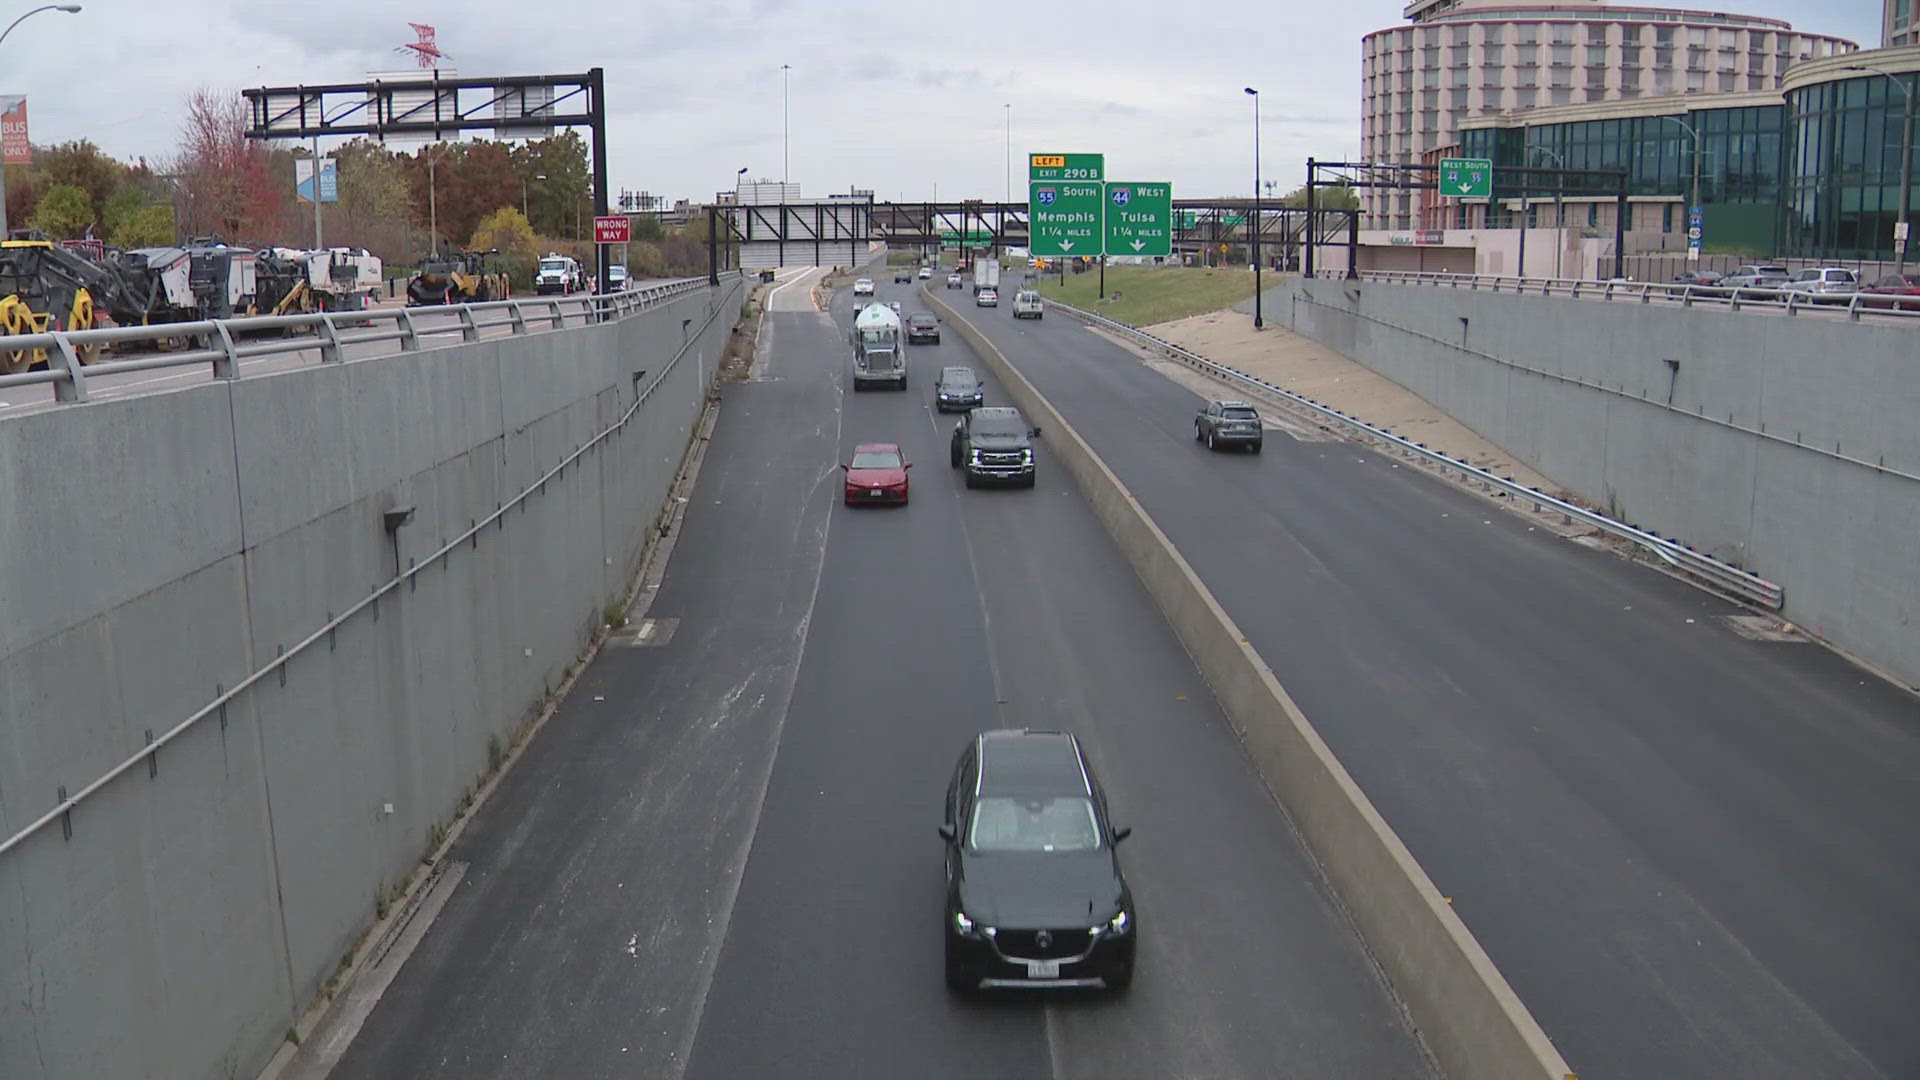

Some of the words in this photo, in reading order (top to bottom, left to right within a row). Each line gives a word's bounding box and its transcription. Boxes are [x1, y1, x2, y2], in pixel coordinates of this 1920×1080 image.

[2, 121, 26, 134] BUS
[4, 146, 27, 156] ONLY
[1035, 157, 1060, 165] LEFT
[1039, 192, 1054, 202] 55
[1063, 187, 1097, 197] SOUTH
[1112, 192, 1129, 202] 44
[1136, 187, 1165, 197] WEST
[1037, 212, 1096, 223] Memphis
[1121, 212, 1156, 223] Tulsa
[597, 220, 627, 229] WRONG
[602, 230, 622, 239] WAY
